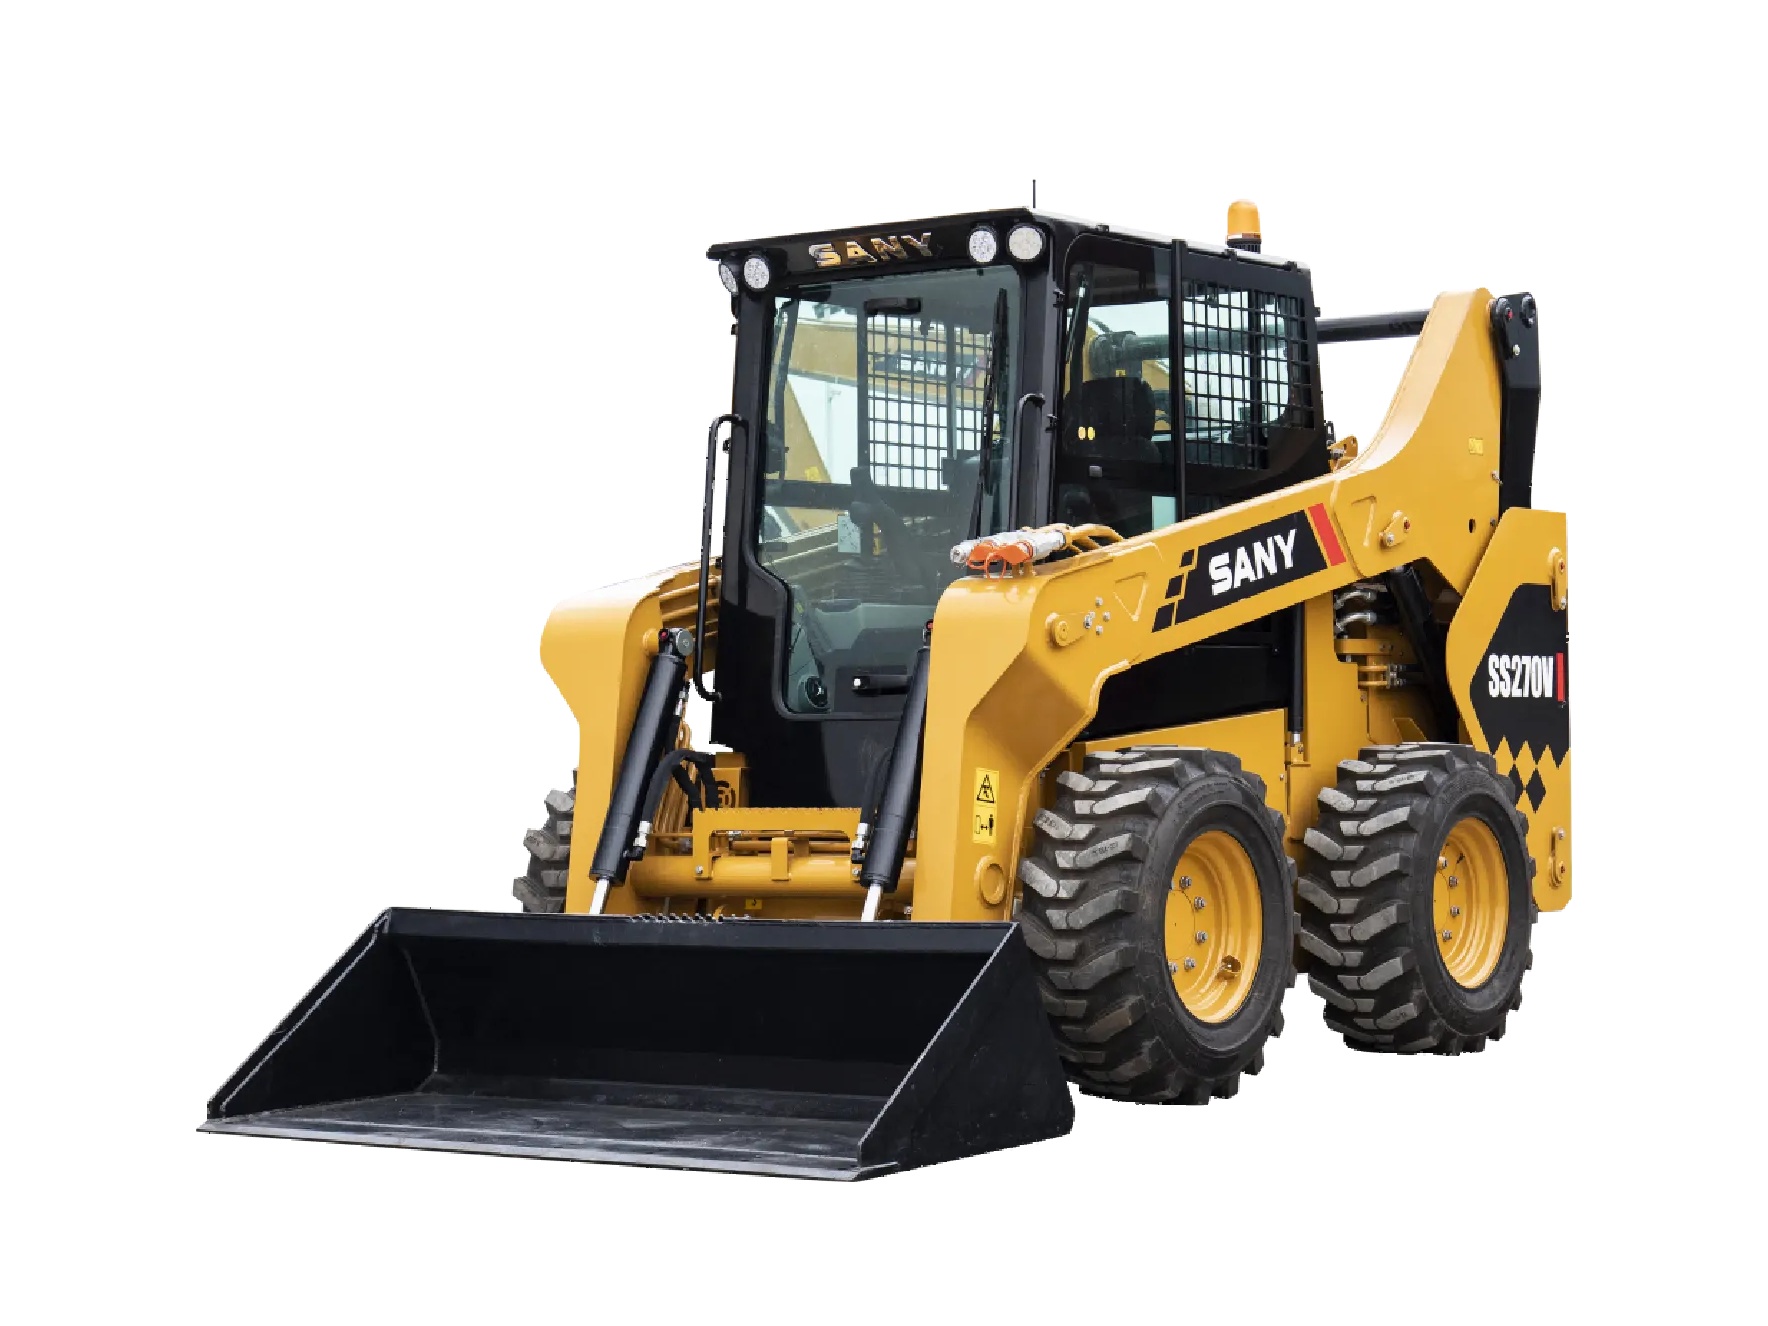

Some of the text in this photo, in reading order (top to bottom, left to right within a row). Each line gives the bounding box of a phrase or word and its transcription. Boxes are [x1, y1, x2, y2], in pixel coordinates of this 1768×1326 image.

[808, 232, 932, 268] SANY
[1208, 528, 1297, 596] SANY
[1488, 653, 1554, 698] SS270V
